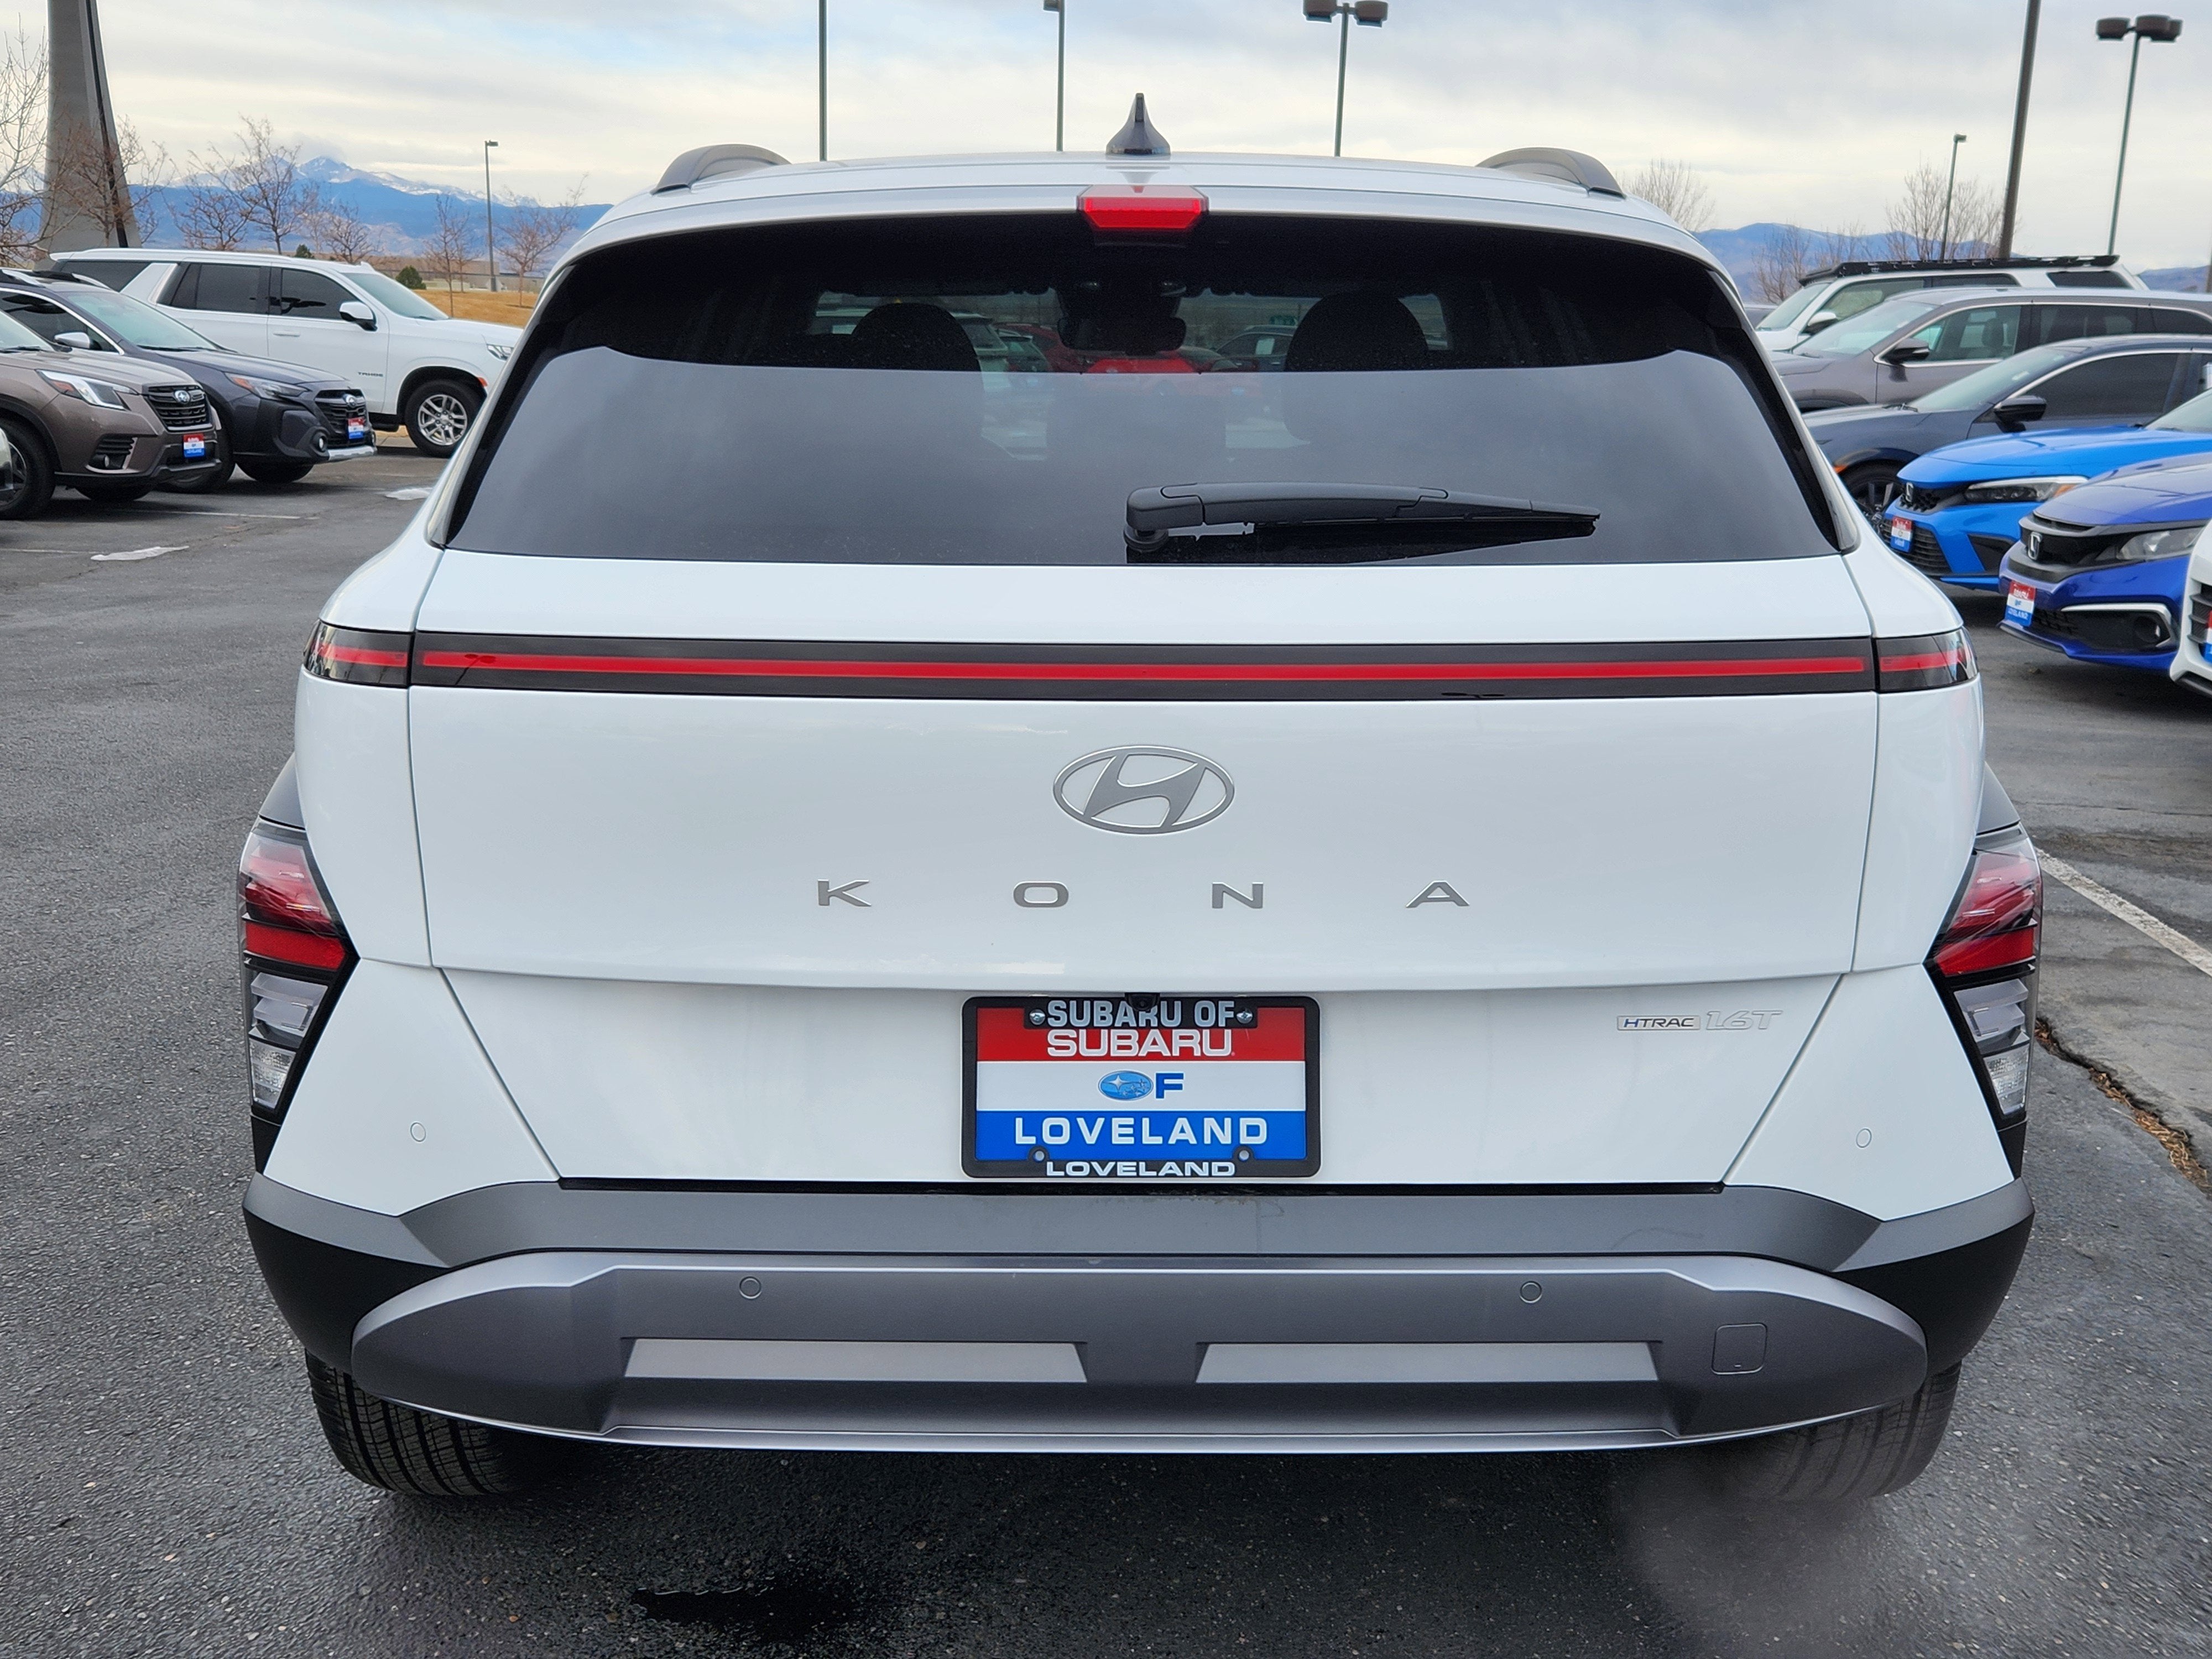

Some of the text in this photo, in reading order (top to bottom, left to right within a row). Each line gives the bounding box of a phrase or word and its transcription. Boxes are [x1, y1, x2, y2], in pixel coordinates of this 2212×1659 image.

[818, 879, 1469, 909] KONA
[1047, 1000, 1235, 1027] SUBARU OF
[1624, 1018, 1694, 1027] HTRAC
[1047, 1029, 1232, 1057] SUBARU
[1015, 1117, 1267, 1145] LOVELAND
[1046, 1162, 1235, 1176] LOVELAND
